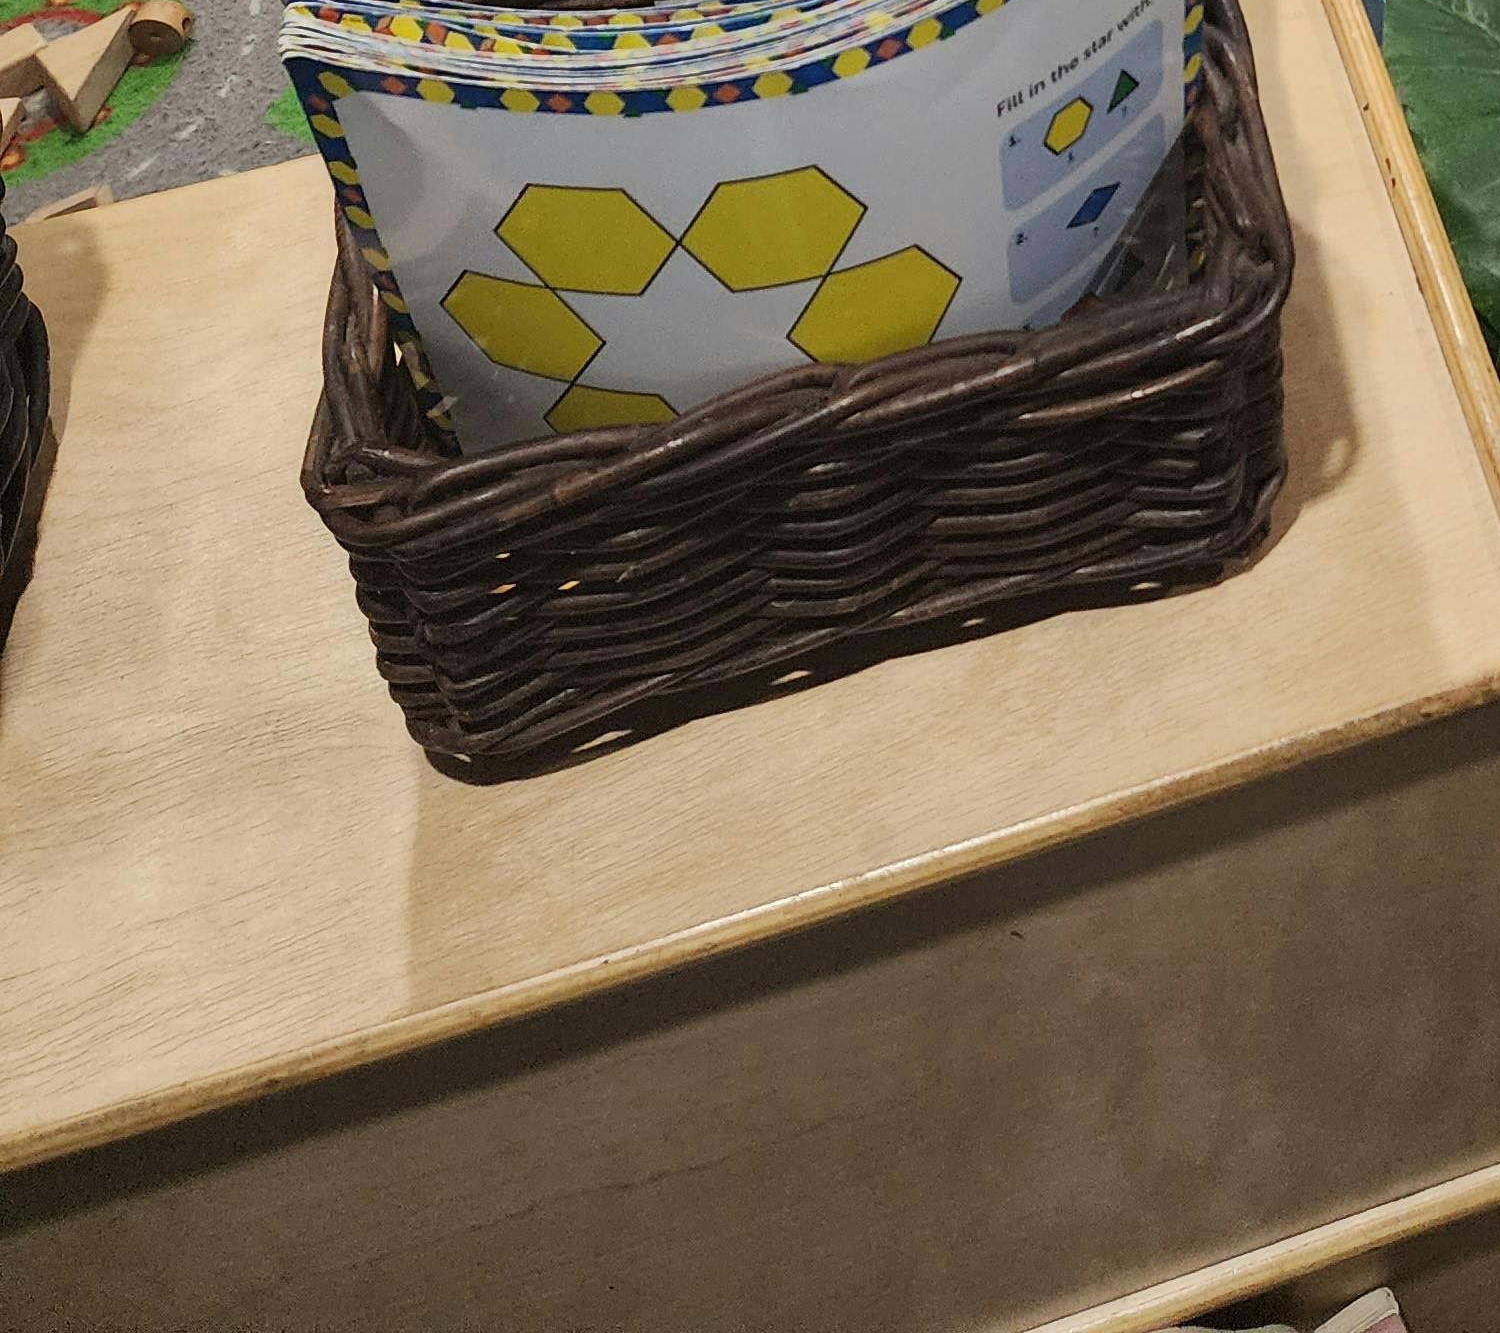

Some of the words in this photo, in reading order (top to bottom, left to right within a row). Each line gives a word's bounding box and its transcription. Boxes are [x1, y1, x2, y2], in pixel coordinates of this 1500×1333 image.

[996, 90, 1024, 117] Fill
[1029, 80, 1046, 97] in
[1051, 56, 1079, 83] the
[1083, 30, 1113, 60] star
